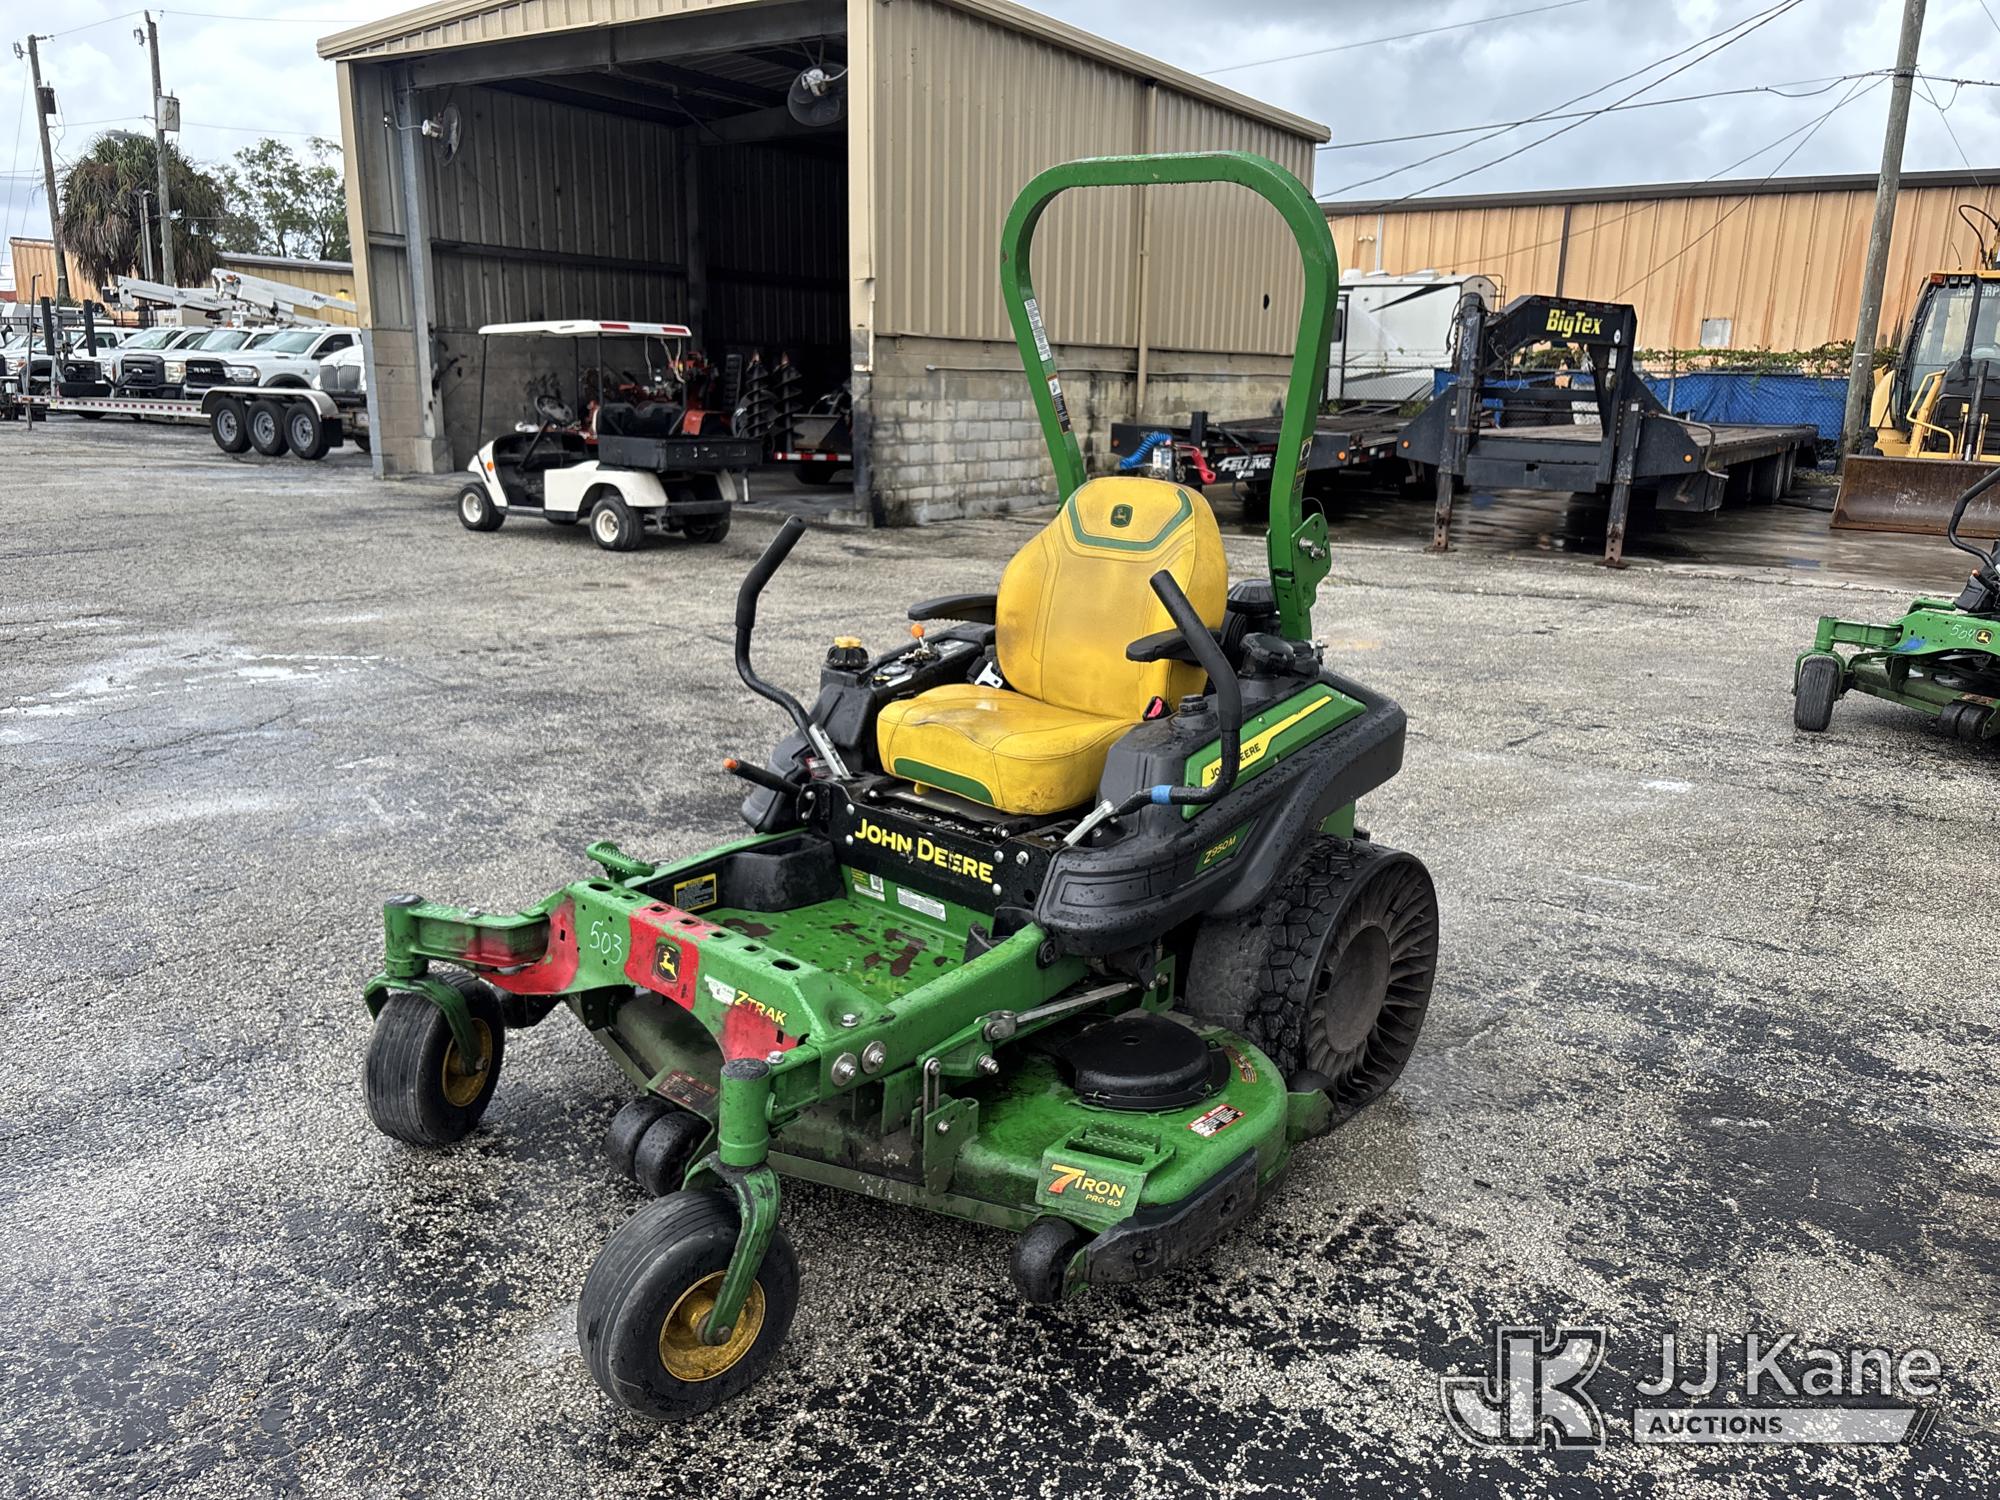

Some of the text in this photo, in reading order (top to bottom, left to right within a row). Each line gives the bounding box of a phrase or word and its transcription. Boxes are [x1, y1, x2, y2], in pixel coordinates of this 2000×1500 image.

[1950, 624, 1976, 643] 504
[1240, 743, 1261, 761] EERE
[855, 818, 993, 884] JOHN DEERE
[1203, 835, 1236, 864] Z950M
[590, 921, 622, 964] 503
[1085, 1193, 1121, 1207] PRO 60
